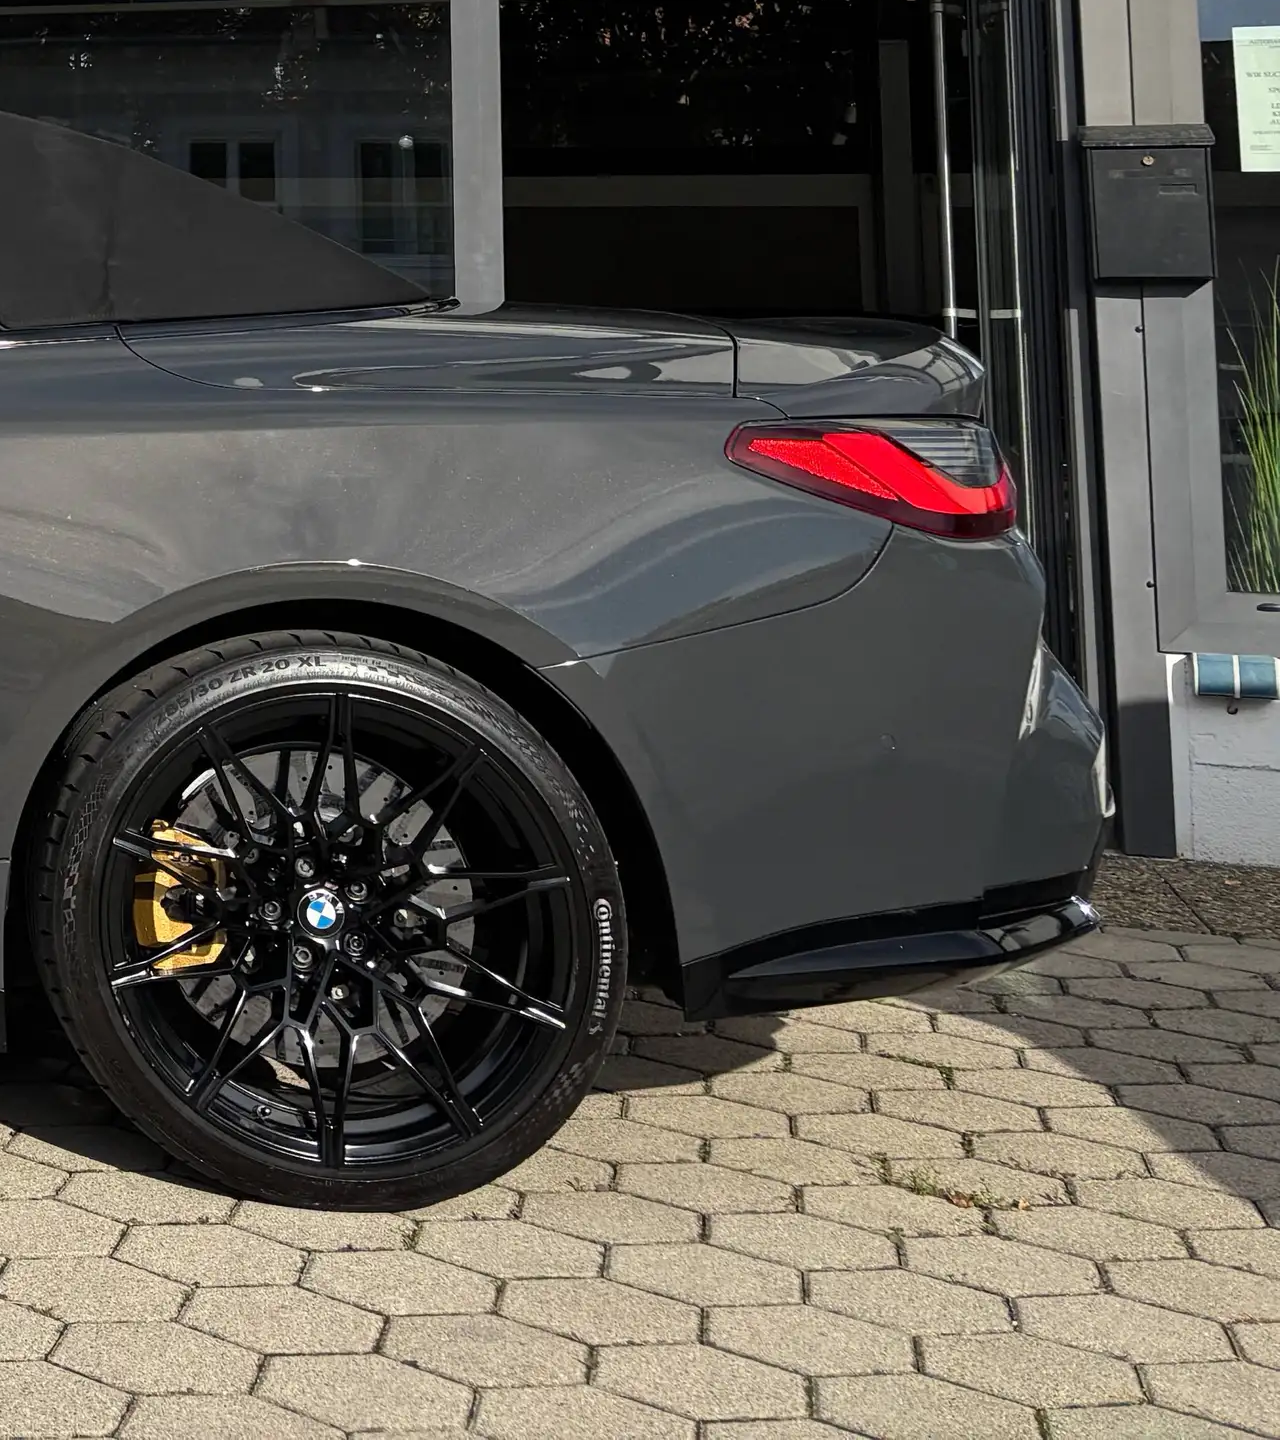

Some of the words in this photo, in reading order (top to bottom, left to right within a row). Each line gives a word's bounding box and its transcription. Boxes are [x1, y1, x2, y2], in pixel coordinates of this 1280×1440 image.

[228, 665, 257, 684] ZR
[261, 658, 291, 674] 20
[296, 655, 327, 668] XL
[591, 898, 616, 1019] Continental
